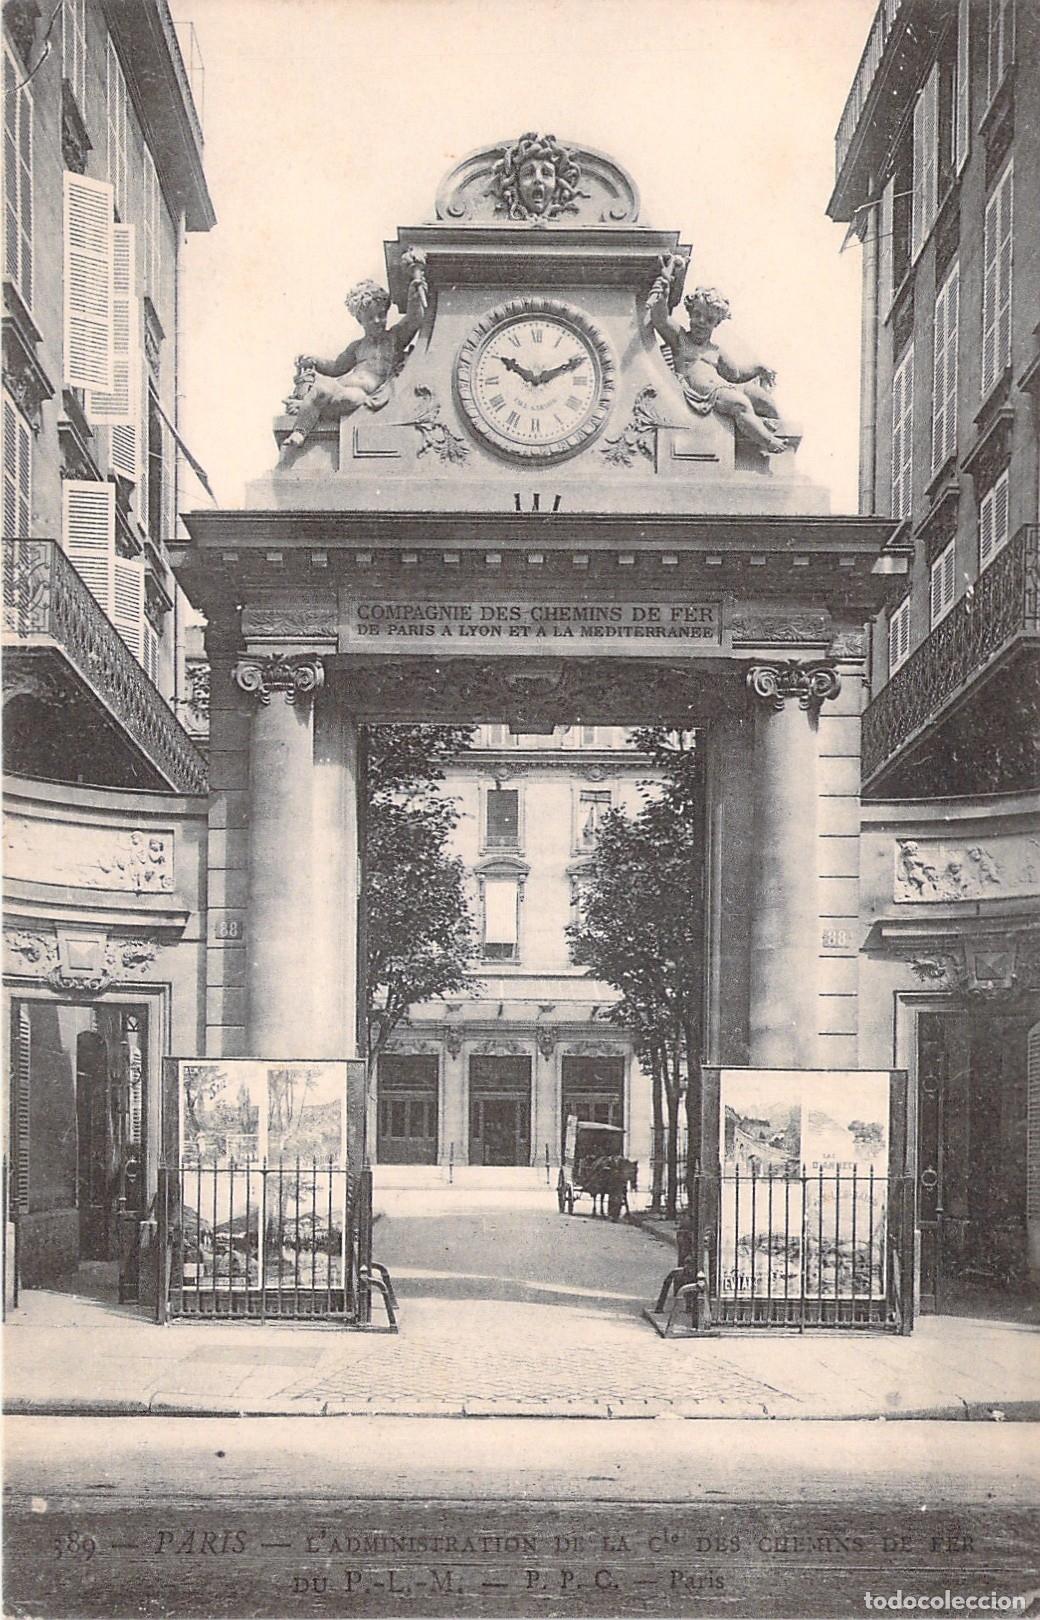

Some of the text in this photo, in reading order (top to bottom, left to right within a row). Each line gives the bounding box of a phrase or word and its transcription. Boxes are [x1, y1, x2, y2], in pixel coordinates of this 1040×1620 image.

[356, 604, 714, 622] COMPAGNIE DES CHEMINS DE FER
[357, 623, 380, 637] DE
[387, 624, 436, 637] PARIS
[458, 625, 502, 637] LYON
[508, 625, 531, 638] ET
[553, 626, 575, 638] LA
[580, 625, 714, 639] MEDITERRANEE
[220, 921, 238, 937] 88
